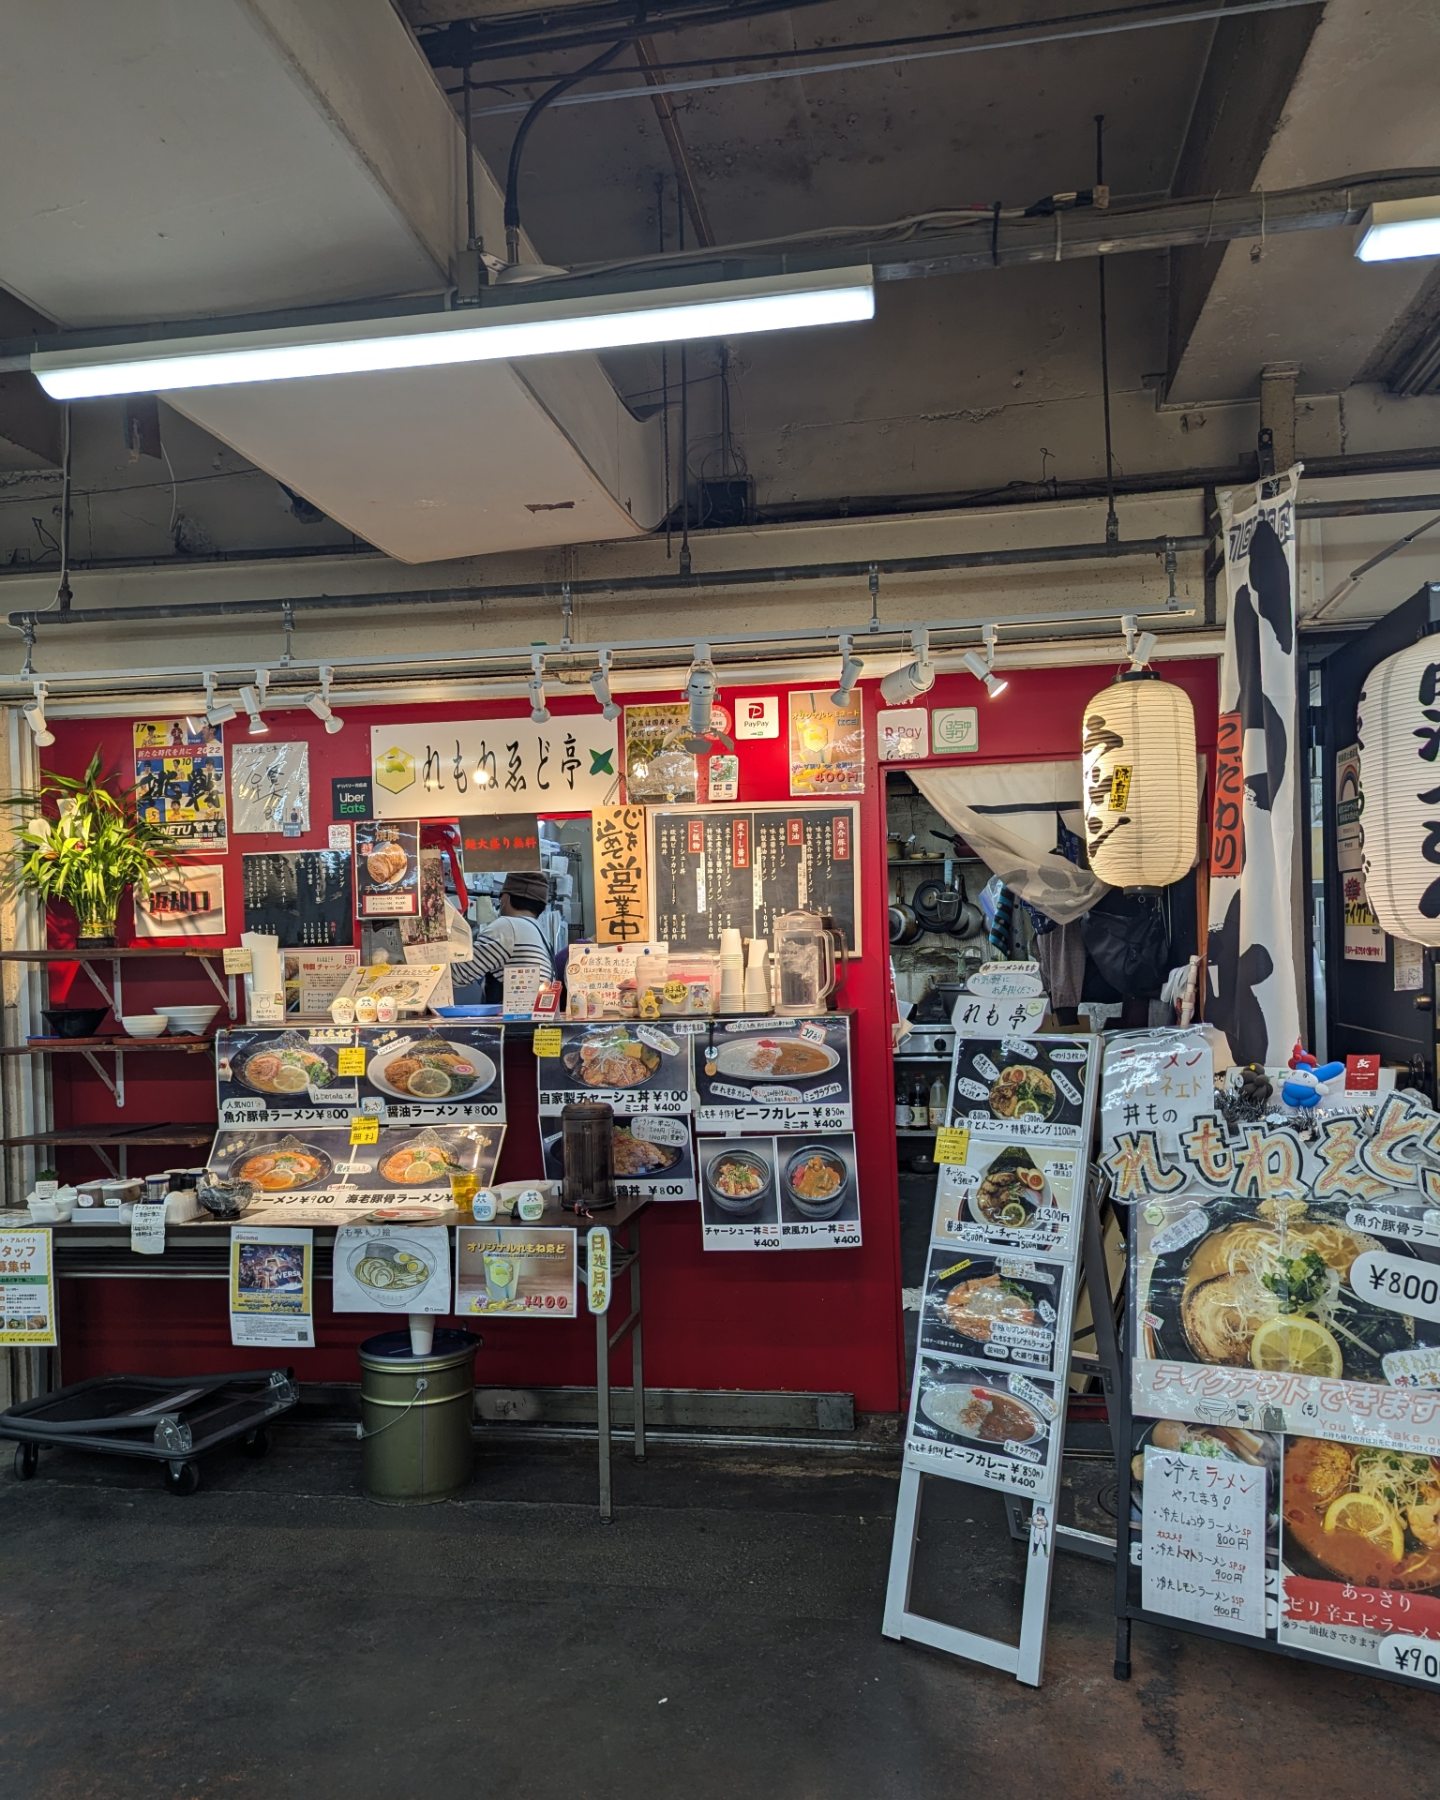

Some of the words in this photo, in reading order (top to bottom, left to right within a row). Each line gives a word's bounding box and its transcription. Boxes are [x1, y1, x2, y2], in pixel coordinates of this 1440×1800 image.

[897, 726, 922, 739] Pay
[196, 746, 221, 755] 2022
[815, 771, 859, 783] 400円
[339, 792, 365, 802] Uber
[1214, 722, 1242, 869] こだわり
[340, 803, 366, 814] Eats
[791, 823, 800, 841] 醤油
[836, 820, 846, 856] 魚介豚骨
[736, 822, 745, 865] 煮干し醤油
[600, 855, 645, 941] 営業中
[962, 1003, 1027, 1031] れも亭
[653, 1090, 688, 1102] ¥900
[386, 1106, 458, 1118] 醤油ラーメン
[463, 1105, 498, 1117] ¥800
[624, 1103, 649, 1113] ミニ丼
[654, 1103, 681, 1112] ¥400
[734, 1107, 810, 1120] ビーフカレー
[1123, 1102, 1178, 1126] 丼もの
[783, 1120, 809, 1129] ミニ丼
[814, 1119, 842, 1129] ¥400
[648, 1185, 684, 1195] ¥800
[1036, 1207, 1070, 1223] 1300円
[753, 1238, 780, 1247] ¥400
[833, 1234, 860, 1244] ¥400
[1369, 1263, 1439, 1305] ¥800
[524, 1295, 568, 1309] ¥400
[1152, 1364, 1313, 1406] テイクアウト
[1319, 1381, 1440, 1425] できます
[1319, 1418, 1346, 1433] You
[943, 1446, 1009, 1469] ビーフカレー
[984, 1469, 1006, 1482] ミニ丼
[1010, 1476, 1036, 1489] ¥400
[1216, 1532, 1249, 1550] 800円
[1214, 1568, 1243, 1584] 900円
[1342, 1583, 1411, 1613] あっさり
[1213, 1605, 1241, 1620] 900円
[1289, 1597, 1440, 1642] ピリ辛エビラーメ
[1393, 1646, 1440, 1678] ¥90
